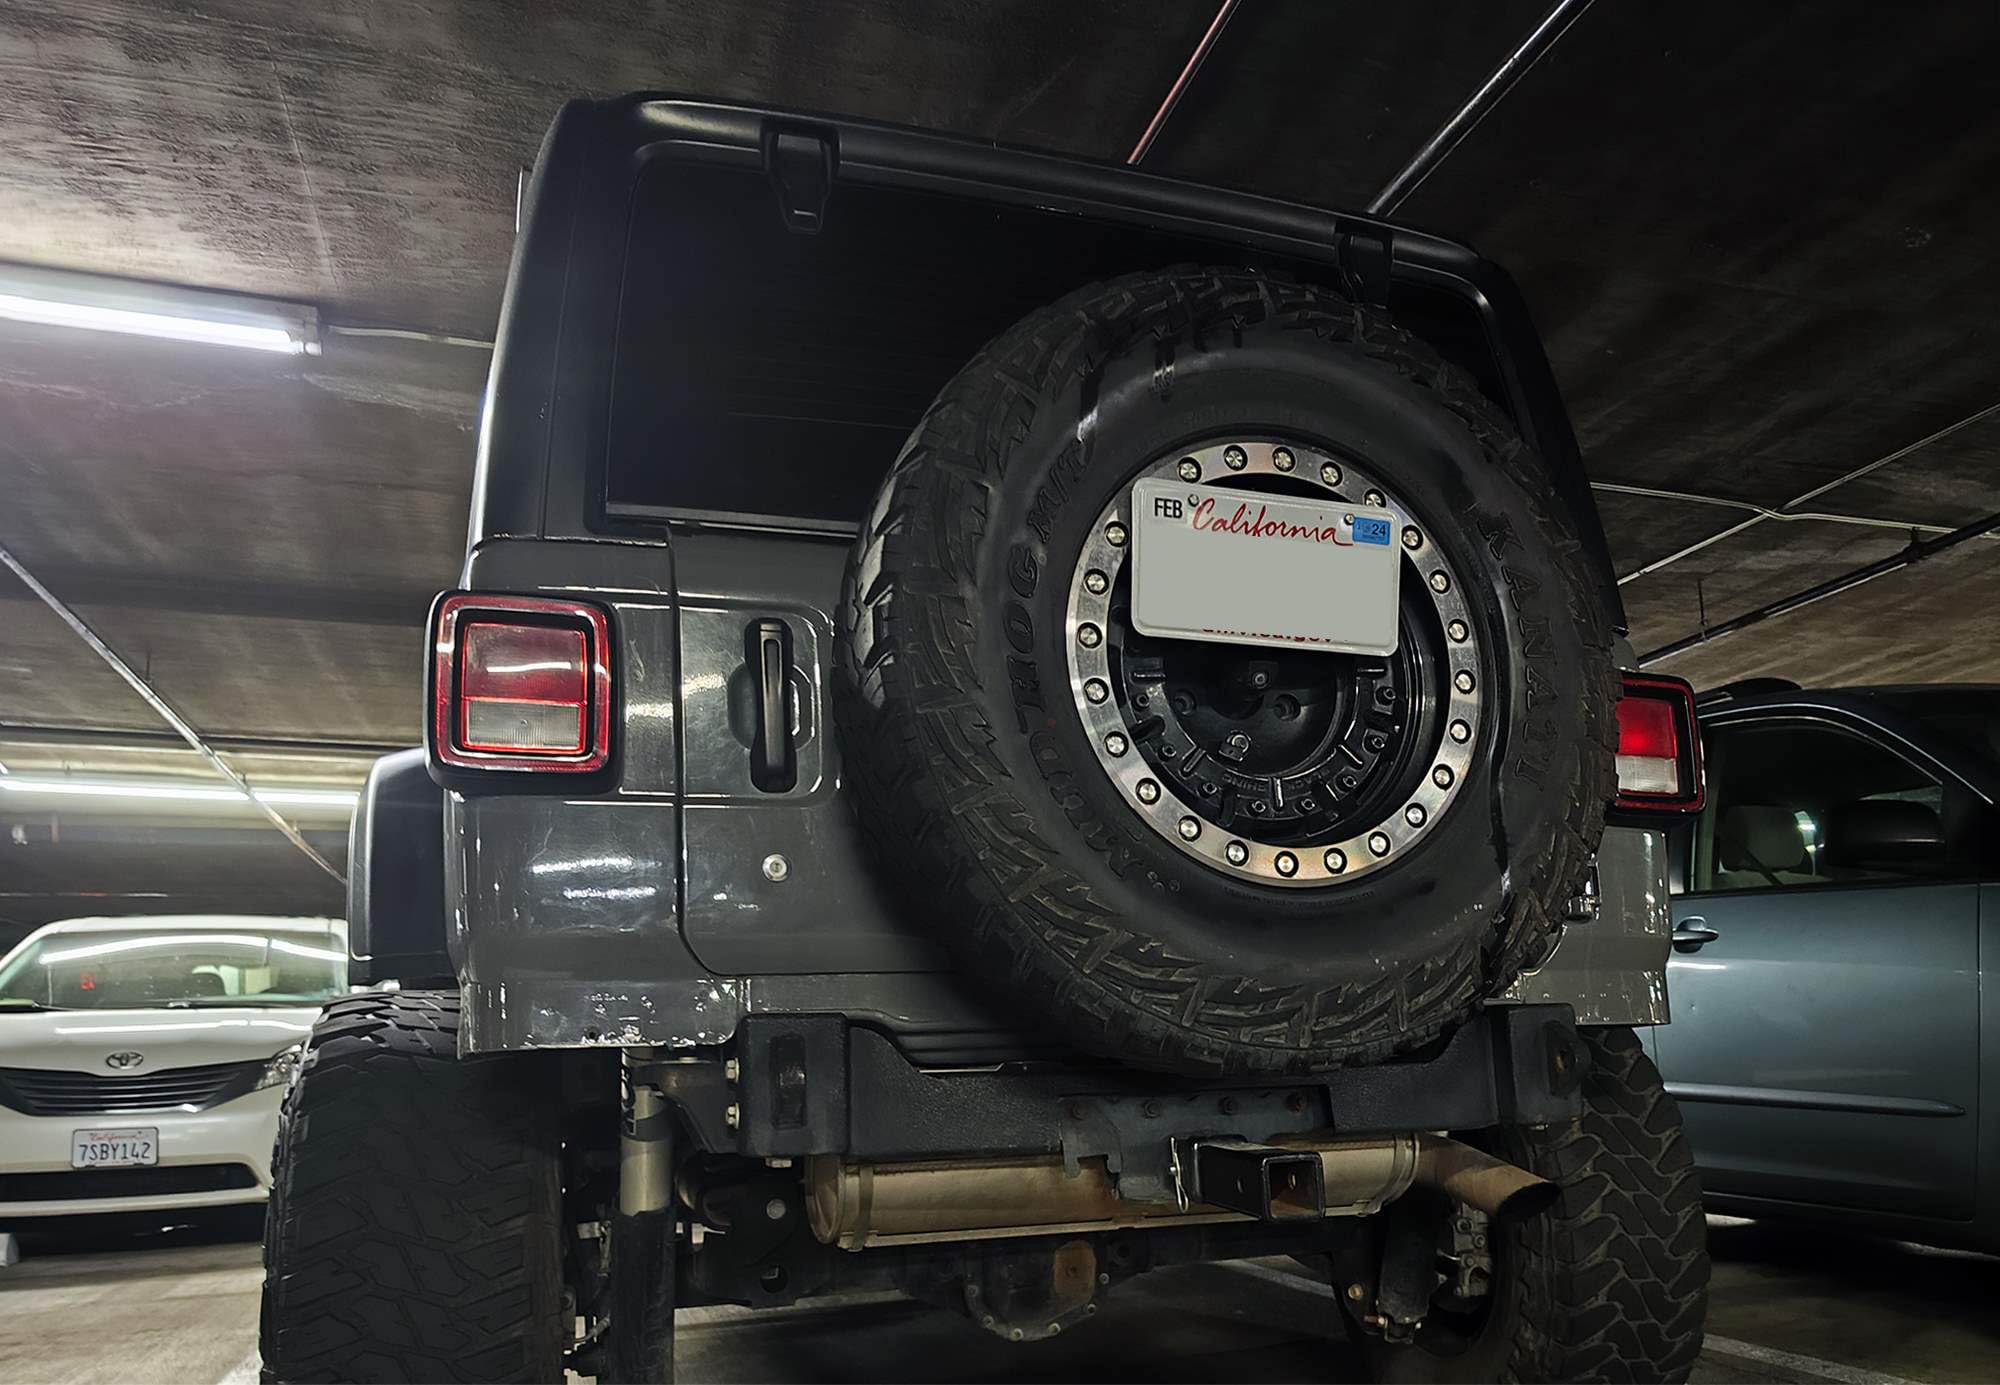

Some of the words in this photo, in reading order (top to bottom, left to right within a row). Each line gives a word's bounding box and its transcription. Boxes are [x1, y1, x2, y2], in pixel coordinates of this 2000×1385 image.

[1154, 497, 1183, 519] FEB
[1191, 498, 1353, 546] California
[1371, 523, 1386, 536] 24
[79, 1142, 151, 1161] 7SBY142
